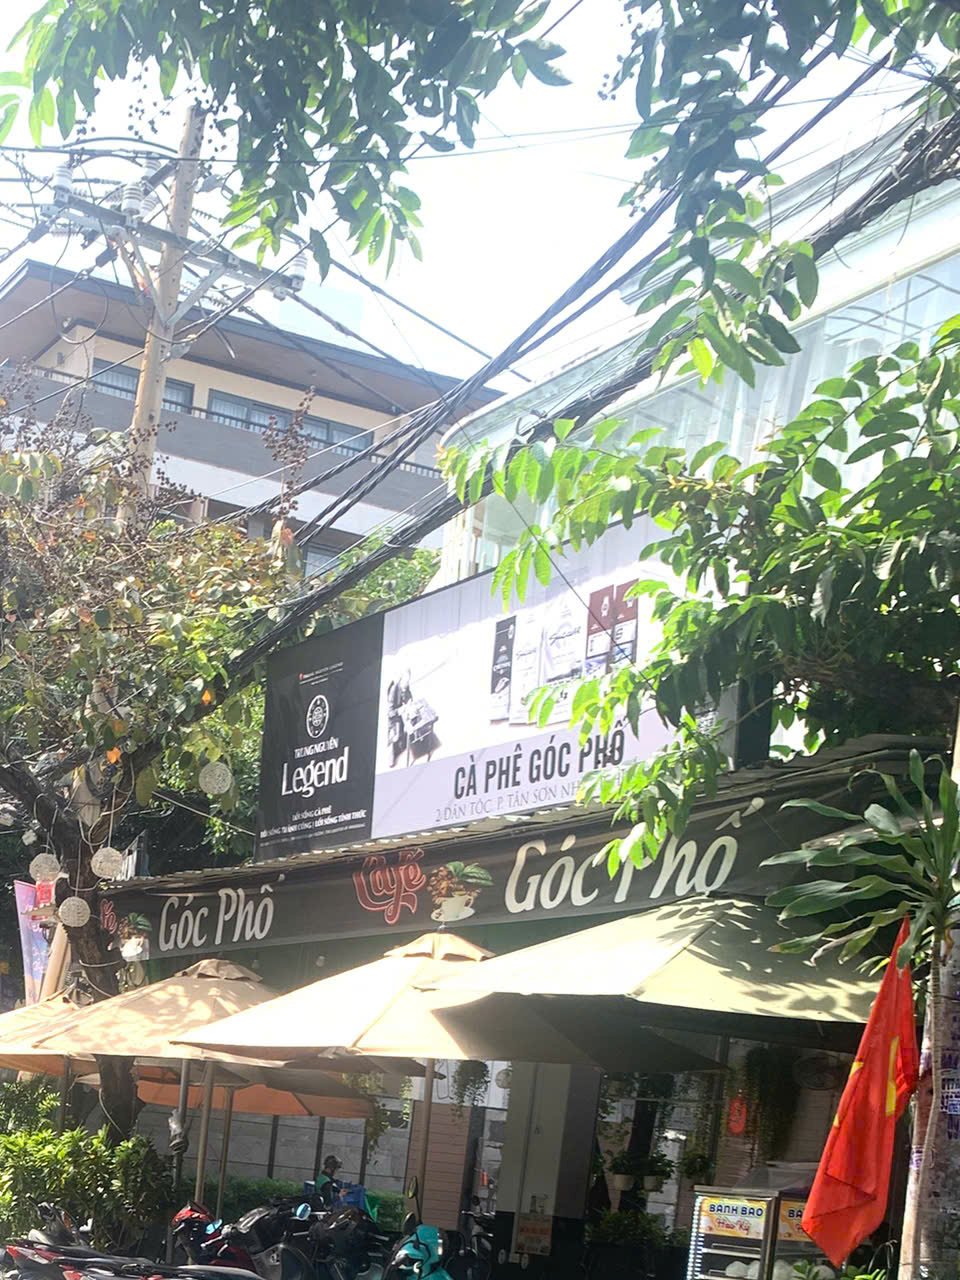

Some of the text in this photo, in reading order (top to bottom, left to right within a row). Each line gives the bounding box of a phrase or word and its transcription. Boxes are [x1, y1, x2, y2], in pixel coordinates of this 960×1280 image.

[281, 746, 350, 798] Legend
[454, 754, 477, 800] CÀ
[484, 743, 523, 794] PHÊ
[528, 734, 572, 784] GÓC
[352, 847, 427, 926] Café
[504, 834, 600, 914] Góc
[158, 895, 209, 952] Góc
[740, 1206, 764, 1217] BAO
